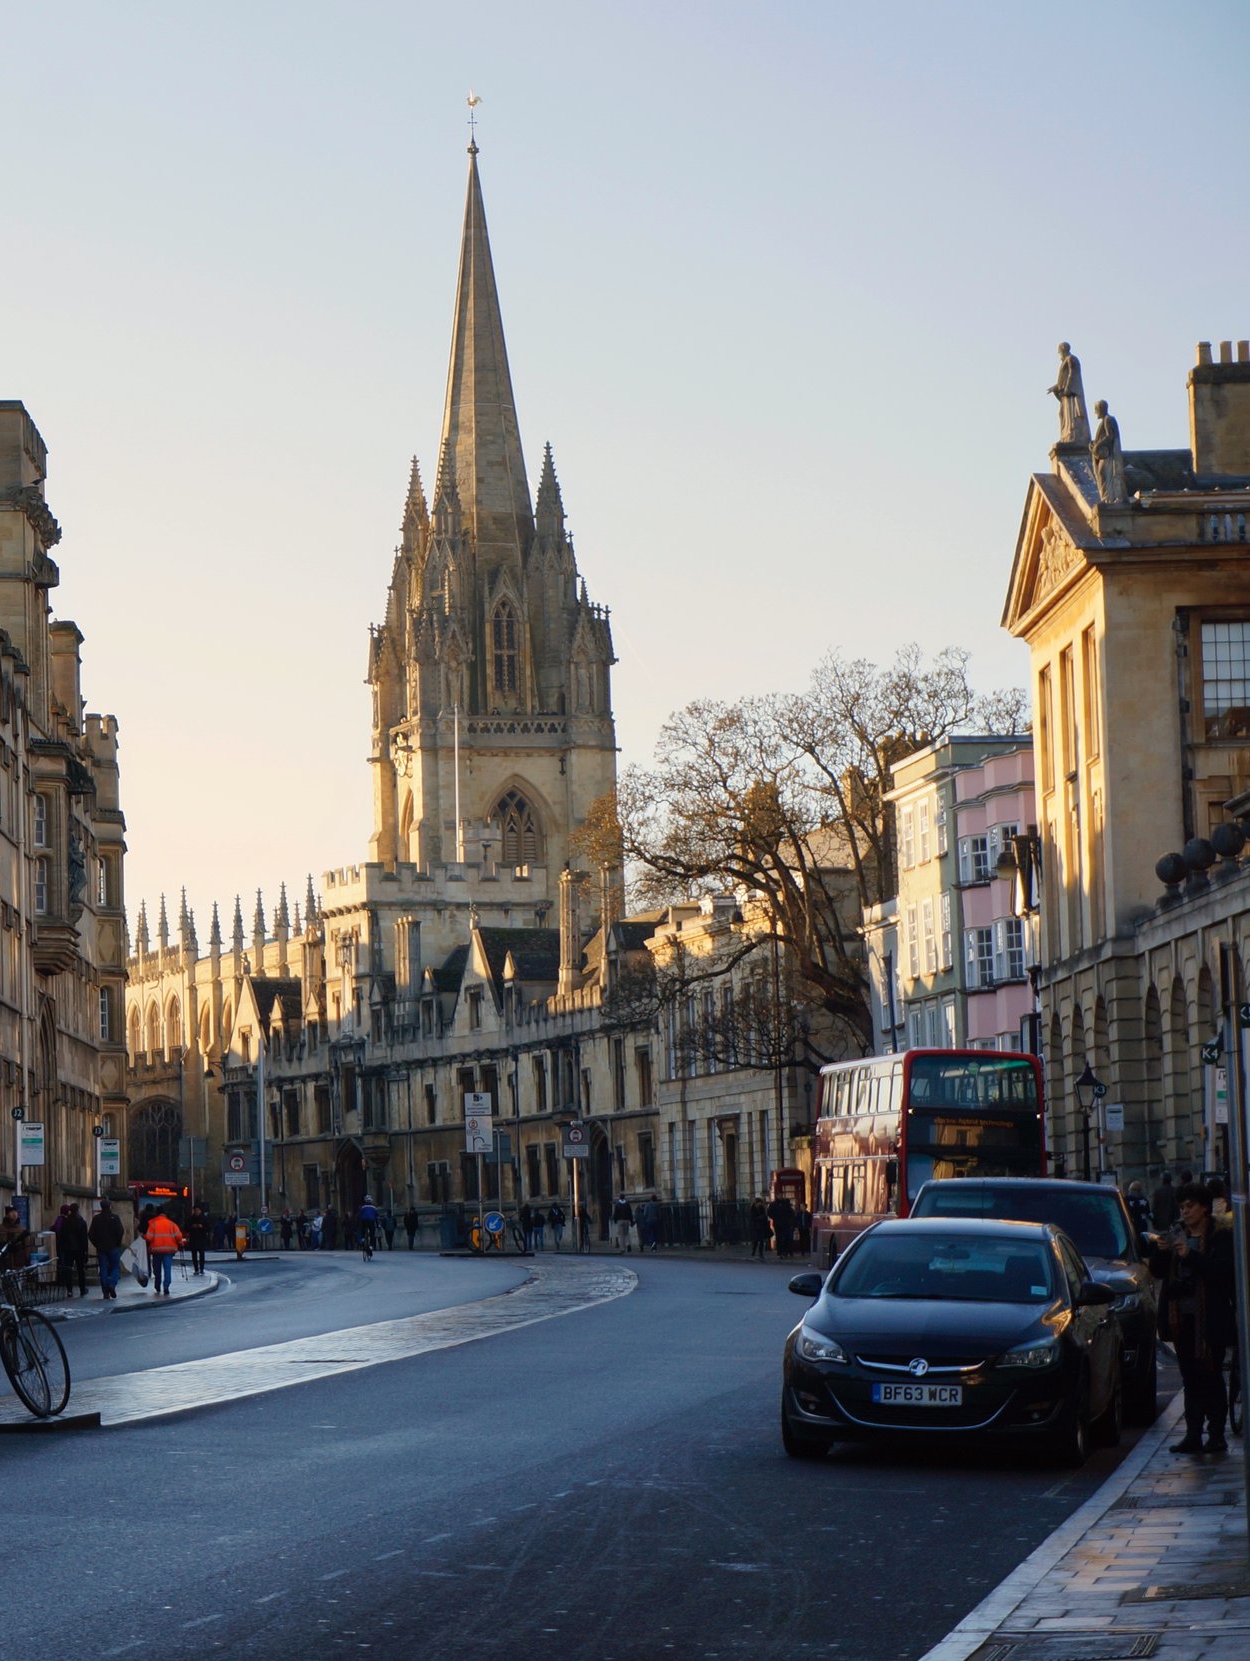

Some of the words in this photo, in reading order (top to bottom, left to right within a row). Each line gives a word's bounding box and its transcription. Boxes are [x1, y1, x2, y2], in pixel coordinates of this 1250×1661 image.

[1202, 1048, 1219, 1059] K4
[1094, 1086, 1106, 1095] K3
[14, 1109, 22, 1117] J2
[883, 1386, 923, 1401] BF63
[928, 1387, 959, 1402] WCR
